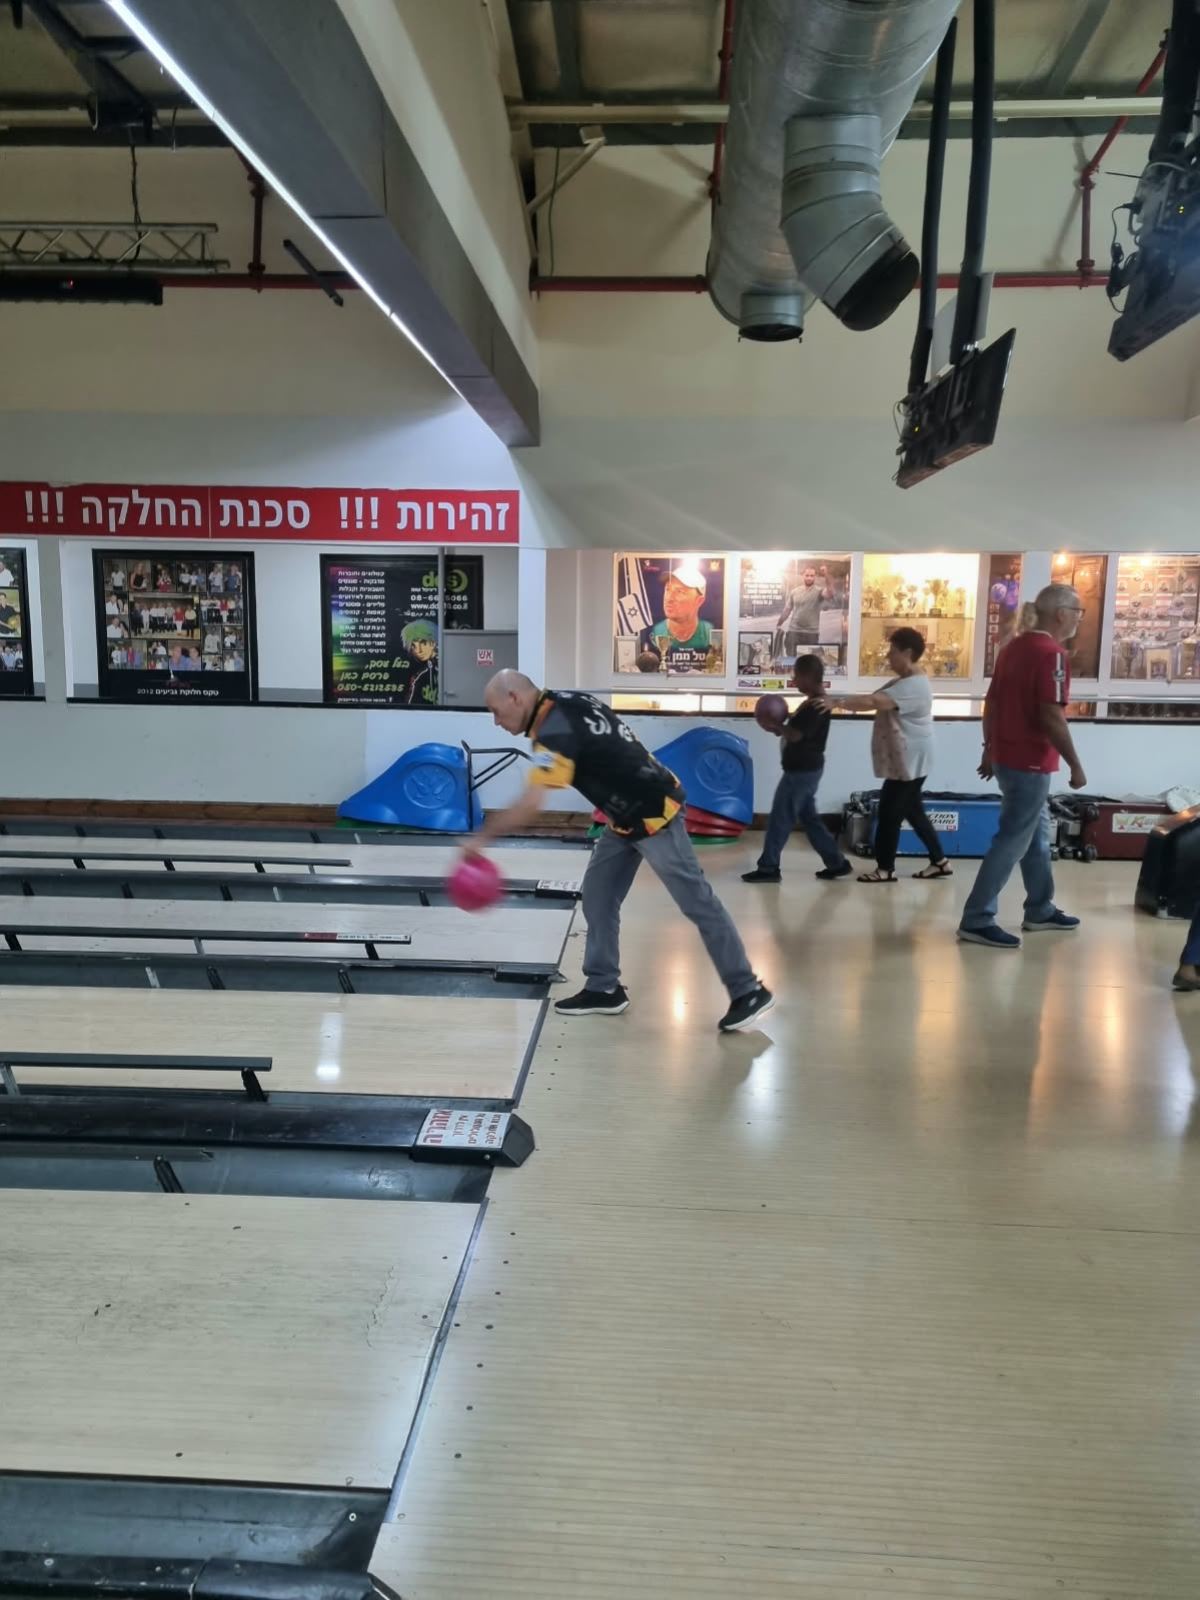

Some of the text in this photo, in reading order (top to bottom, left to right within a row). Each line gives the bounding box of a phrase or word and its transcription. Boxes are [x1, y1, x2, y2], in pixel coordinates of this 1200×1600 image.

[24, 488, 510, 533] זהירות !!! סכנת החלקה !!!
[672, 652, 690, 665] ממן
[692, 651, 706, 661] טל
[180, 688, 201, 696] חלוקת
